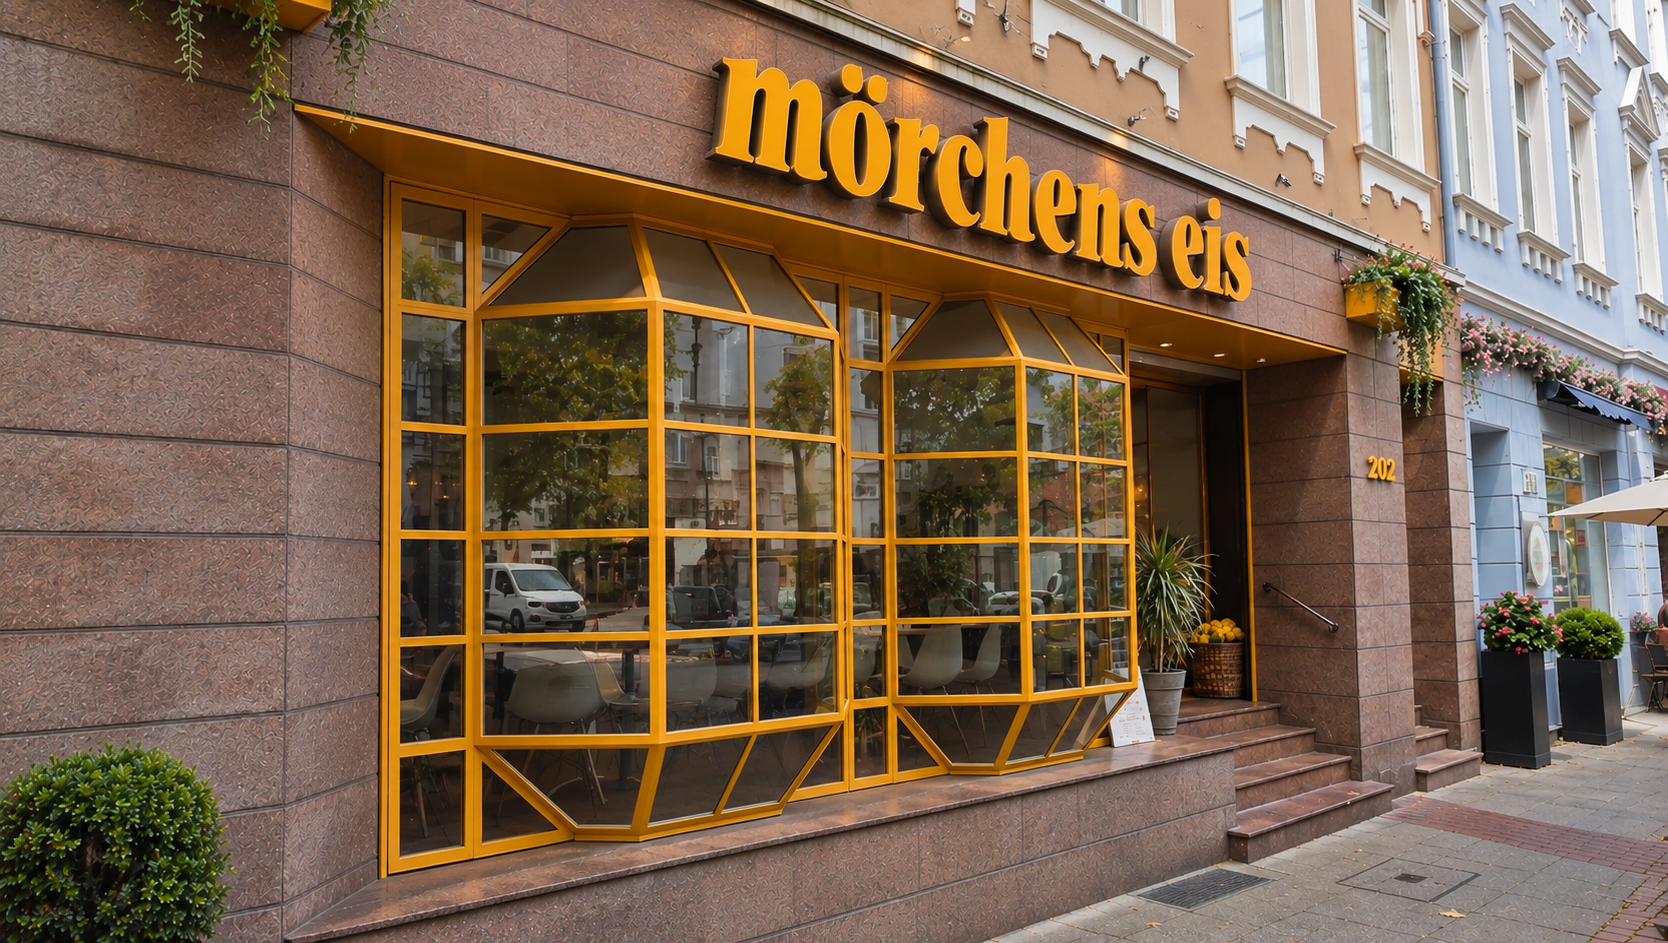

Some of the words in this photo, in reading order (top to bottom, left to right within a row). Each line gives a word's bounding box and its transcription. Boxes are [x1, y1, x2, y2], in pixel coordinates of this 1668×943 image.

[707, 57, 1157, 277] mörchens
[1162, 197, 1252, 302] eis
[1367, 455, 1396, 482] 202
